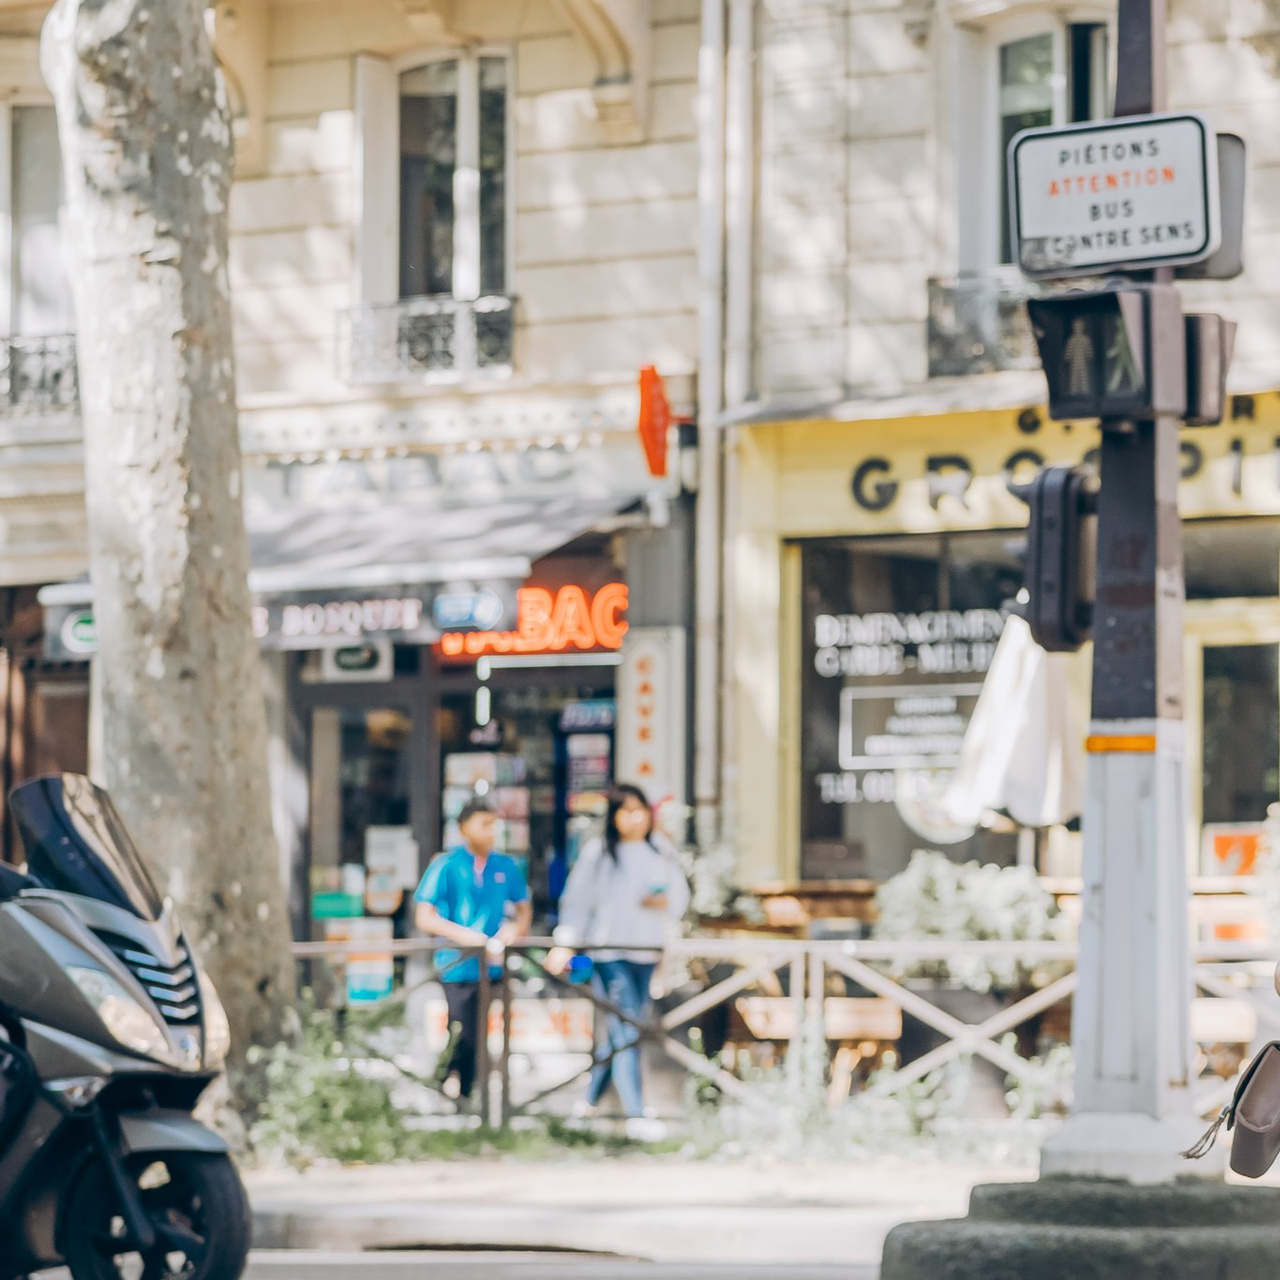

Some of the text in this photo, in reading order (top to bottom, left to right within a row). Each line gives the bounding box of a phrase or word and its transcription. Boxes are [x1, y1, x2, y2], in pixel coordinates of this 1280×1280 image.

[1058, 138, 1160, 167] PIÉTONS
[1048, 167, 1176, 197] ATTENTION
[1089, 199, 1134, 221] BUS
[1053, 221, 1195, 256] CONTRE SENS
